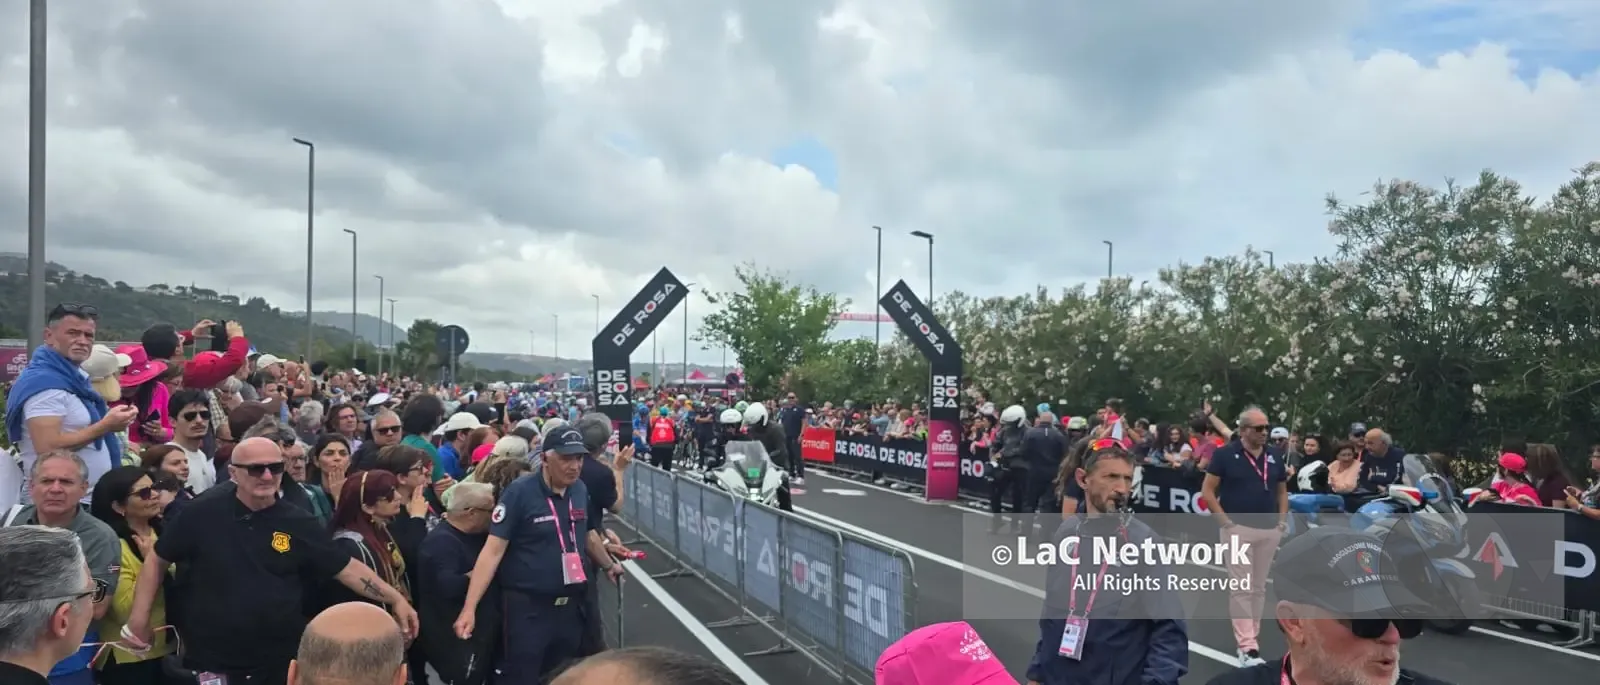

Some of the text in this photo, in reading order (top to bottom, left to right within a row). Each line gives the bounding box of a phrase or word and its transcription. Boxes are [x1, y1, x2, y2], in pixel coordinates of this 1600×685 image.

[612, 284, 677, 346] DE ROSA
[892, 291, 945, 355] DE ROSA
[597, 370, 626, 381] DE
[933, 375, 957, 386] DE
[598, 382, 629, 393] RO
[933, 387, 959, 398] RO
[598, 394, 629, 406] SA
[933, 397, 958, 408] SA
[835, 440, 847, 454] DE
[849, 442, 877, 460] ROSA
[880, 446, 896, 463] DE
[961, 458, 984, 478] RO
[1170, 487, 1213, 516] RO
[1553, 540, 1597, 578] D
